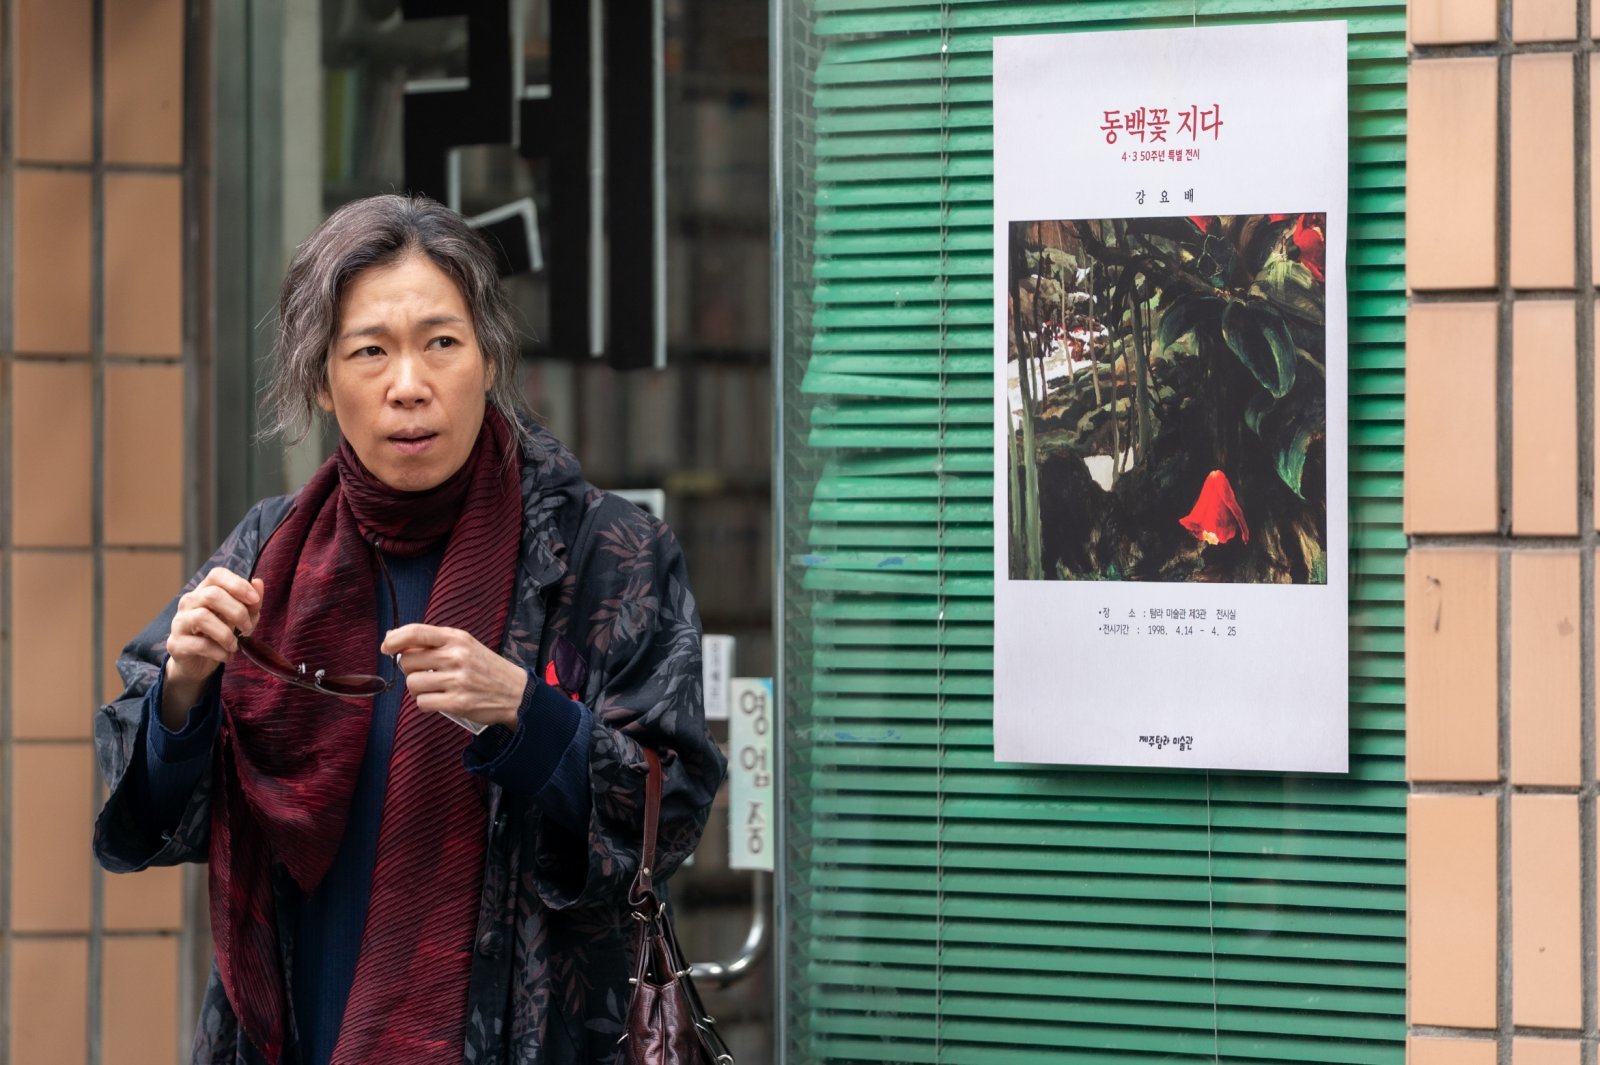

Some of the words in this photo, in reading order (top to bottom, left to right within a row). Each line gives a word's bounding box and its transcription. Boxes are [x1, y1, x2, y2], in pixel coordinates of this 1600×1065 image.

[1100, 106, 1170, 144] 동백꽃
[1176, 103, 1224, 142] 지다
[1140, 150, 1165, 162] 50주년
[1168, 149, 1183, 162] 특별
[1185, 148, 1200, 161] 전시
[1149, 607, 1163, 619] 탐라
[1166, 608, 1186, 620] 미술관
[1188, 608, 1207, 620] 제3관
[1216, 609, 1236, 621] 전시실
[1103, 624, 1129, 635] 전시기간
[1227, 626, 1237, 637] 25
